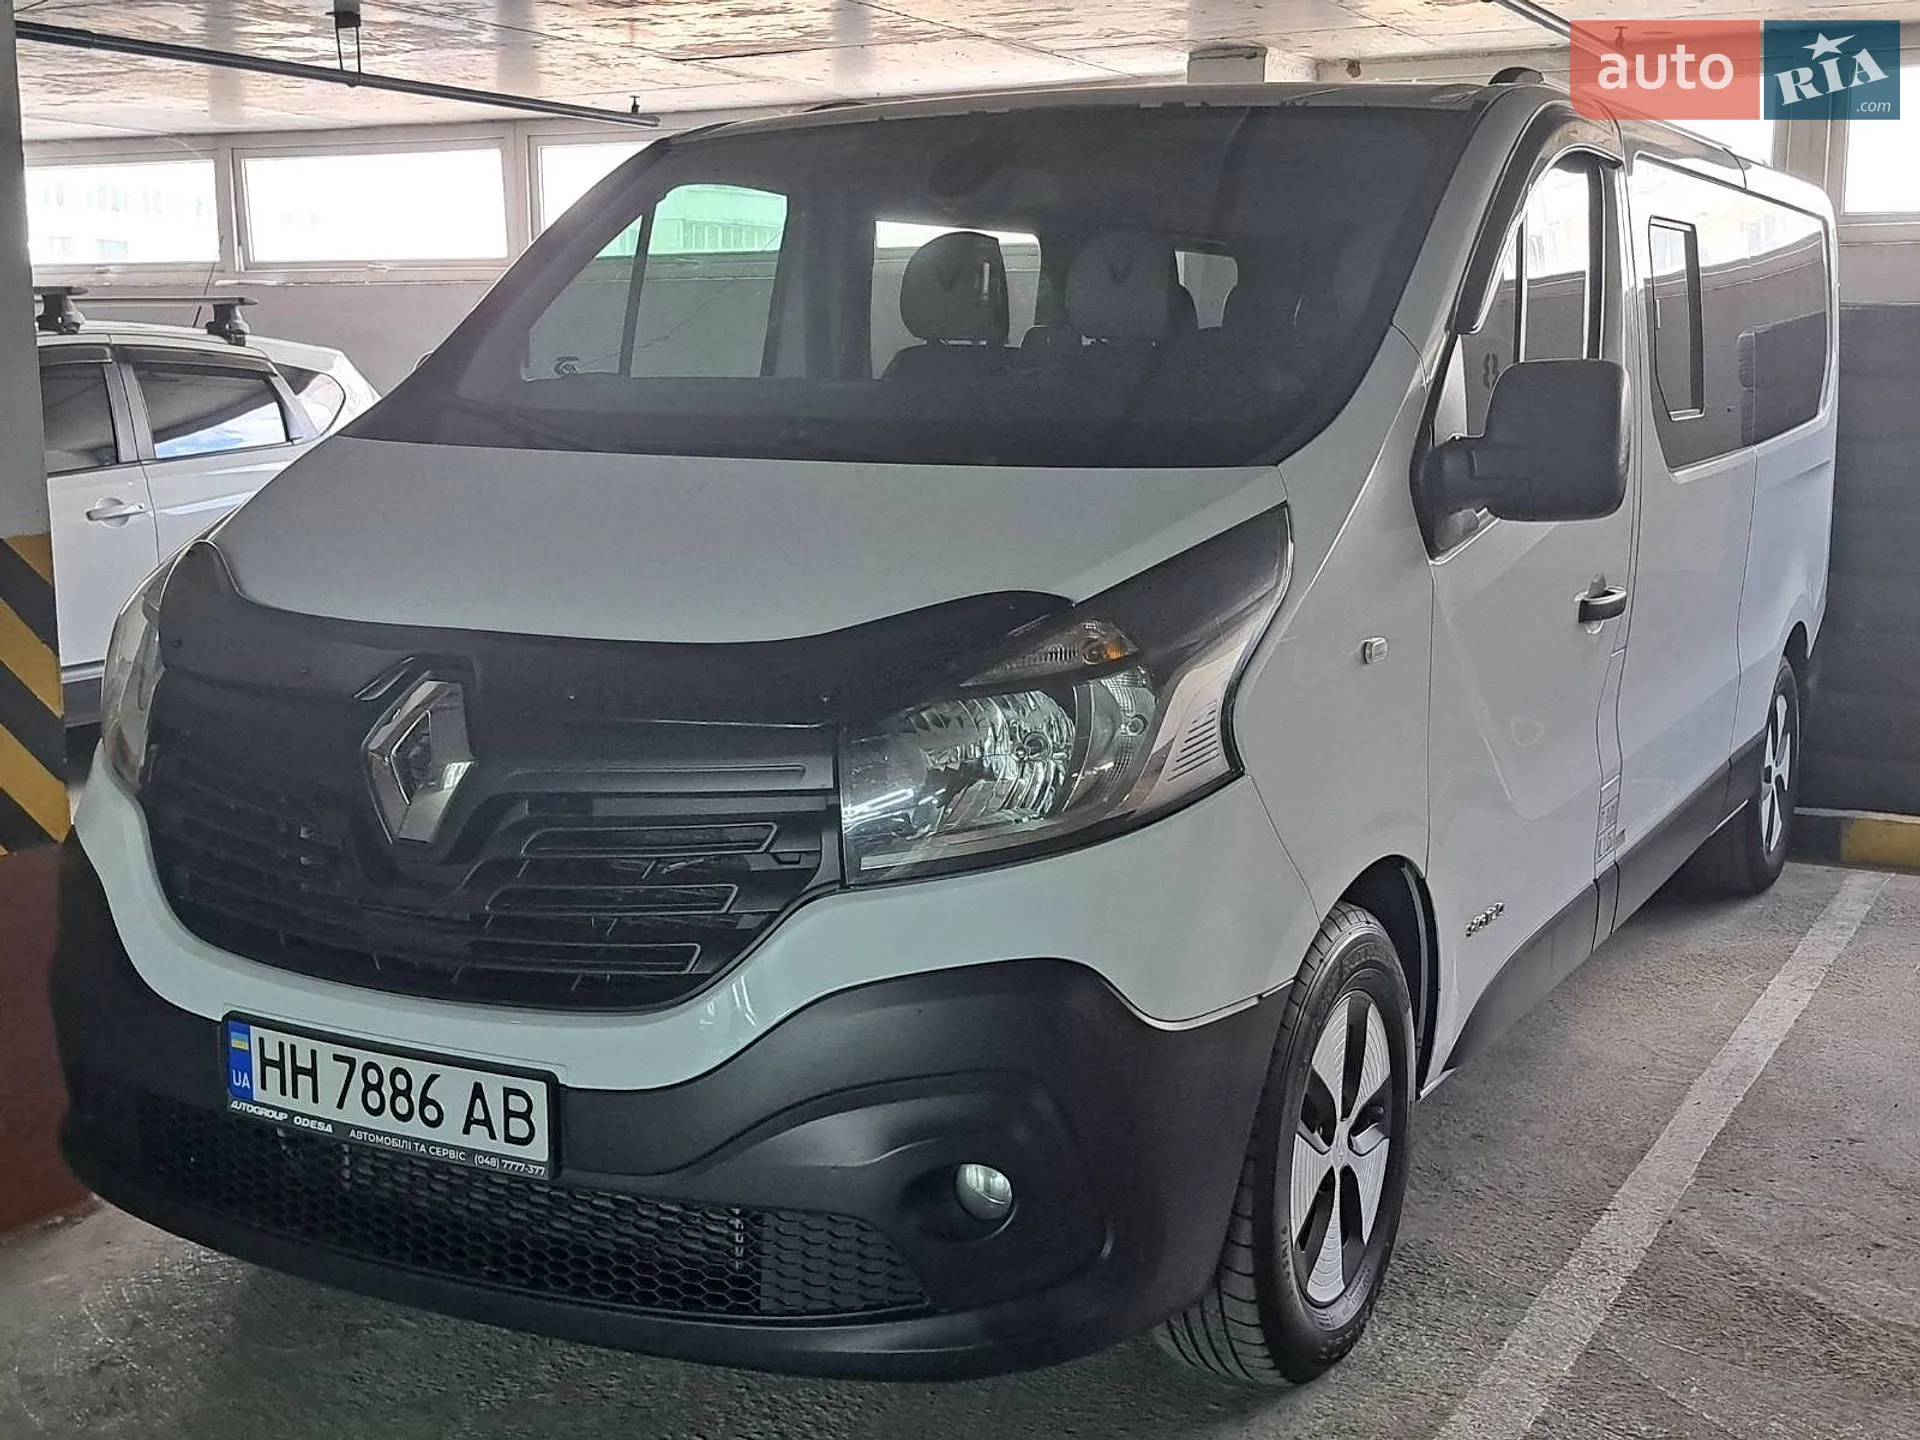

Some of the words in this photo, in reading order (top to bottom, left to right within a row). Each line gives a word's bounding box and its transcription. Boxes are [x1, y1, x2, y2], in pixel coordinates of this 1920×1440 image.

[232, 1069, 251, 1089] UA
[258, 1036, 319, 1104] HH
[332, 1053, 445, 1129] 7886
[462, 1081, 536, 1146] AB
[231, 1100, 288, 1121] AUTOGROUP
[293, 1115, 334, 1133] ODESA
[428, 1146, 466, 1161] СЕРВІС
[474, 1154, 500, 1169] (048)
[501, 1160, 545, 1176] 7777-377
